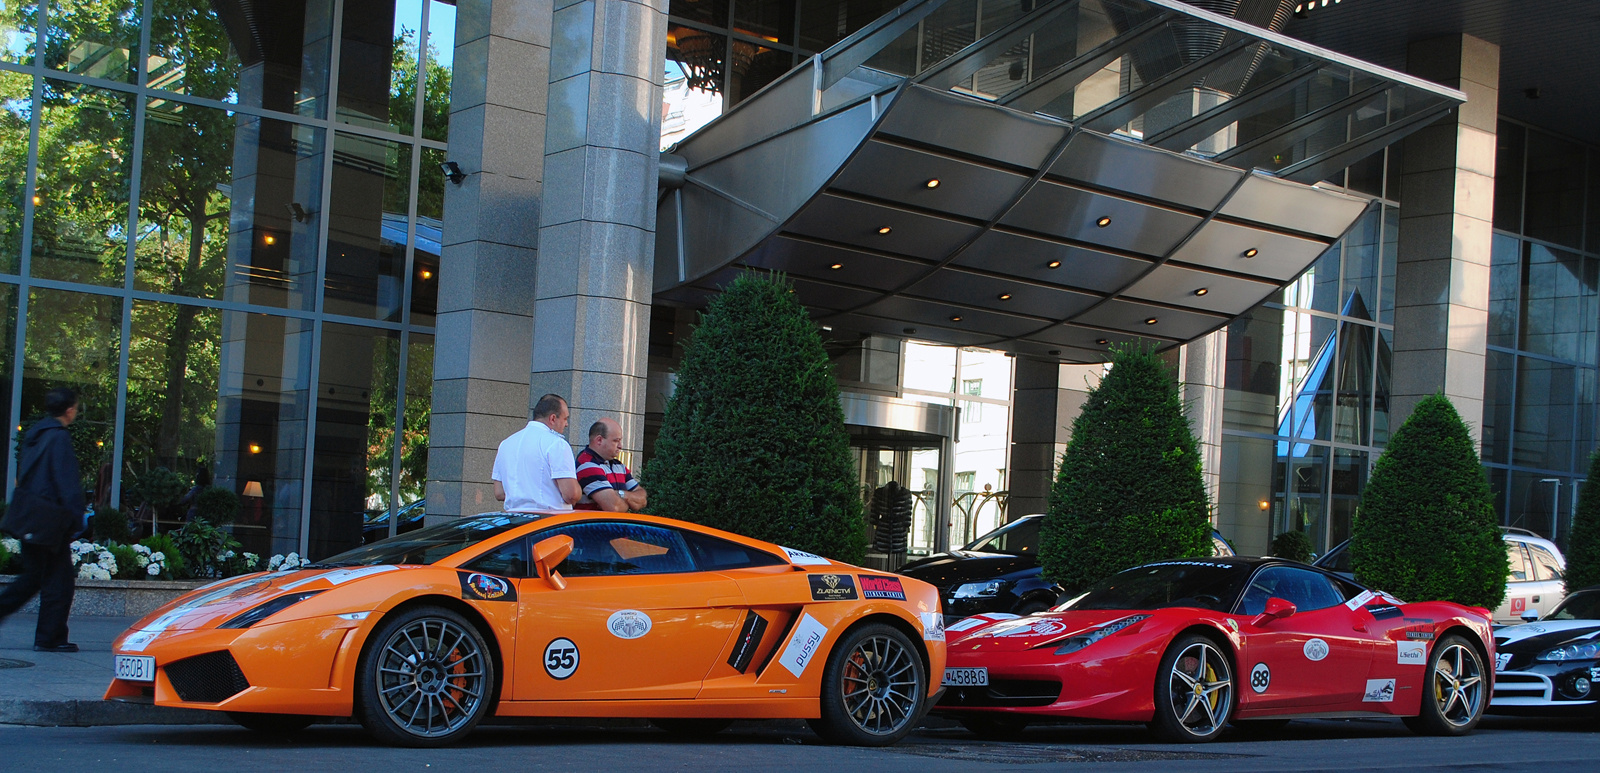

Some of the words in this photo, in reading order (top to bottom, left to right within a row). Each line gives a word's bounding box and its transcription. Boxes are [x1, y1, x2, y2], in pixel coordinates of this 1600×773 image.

[547, 648, 575, 670] 55
[796, 631, 821, 667] pussy
[1252, 670, 1269, 687] 88
